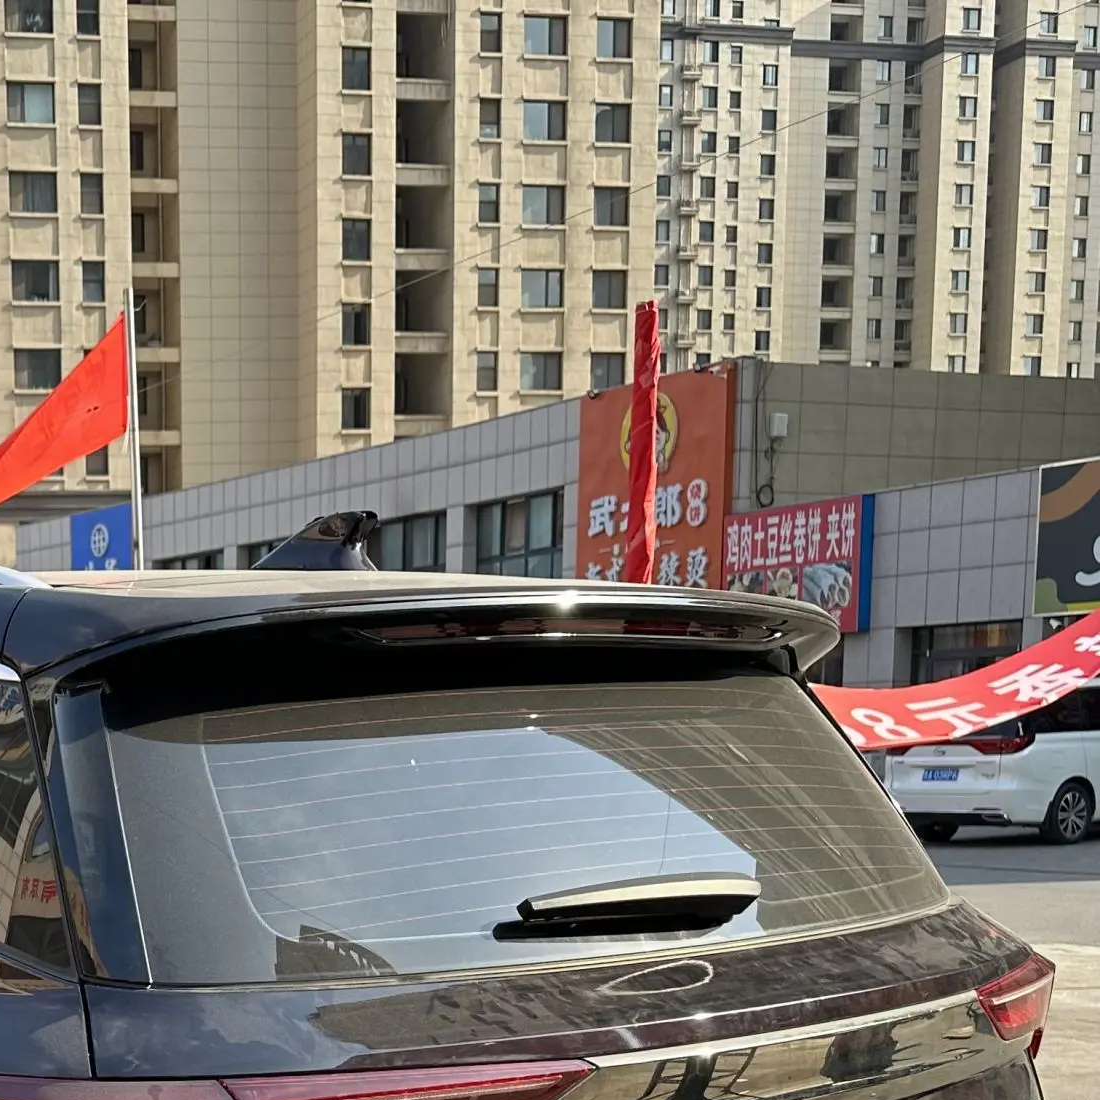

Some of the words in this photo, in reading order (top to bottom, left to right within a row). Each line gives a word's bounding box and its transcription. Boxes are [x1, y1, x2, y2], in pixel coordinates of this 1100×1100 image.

[587, 483, 683, 537] 武郎
[726, 507, 821, 571] 鸡肉土豆丝卷饼
[826, 502, 855, 560] 夹饼
